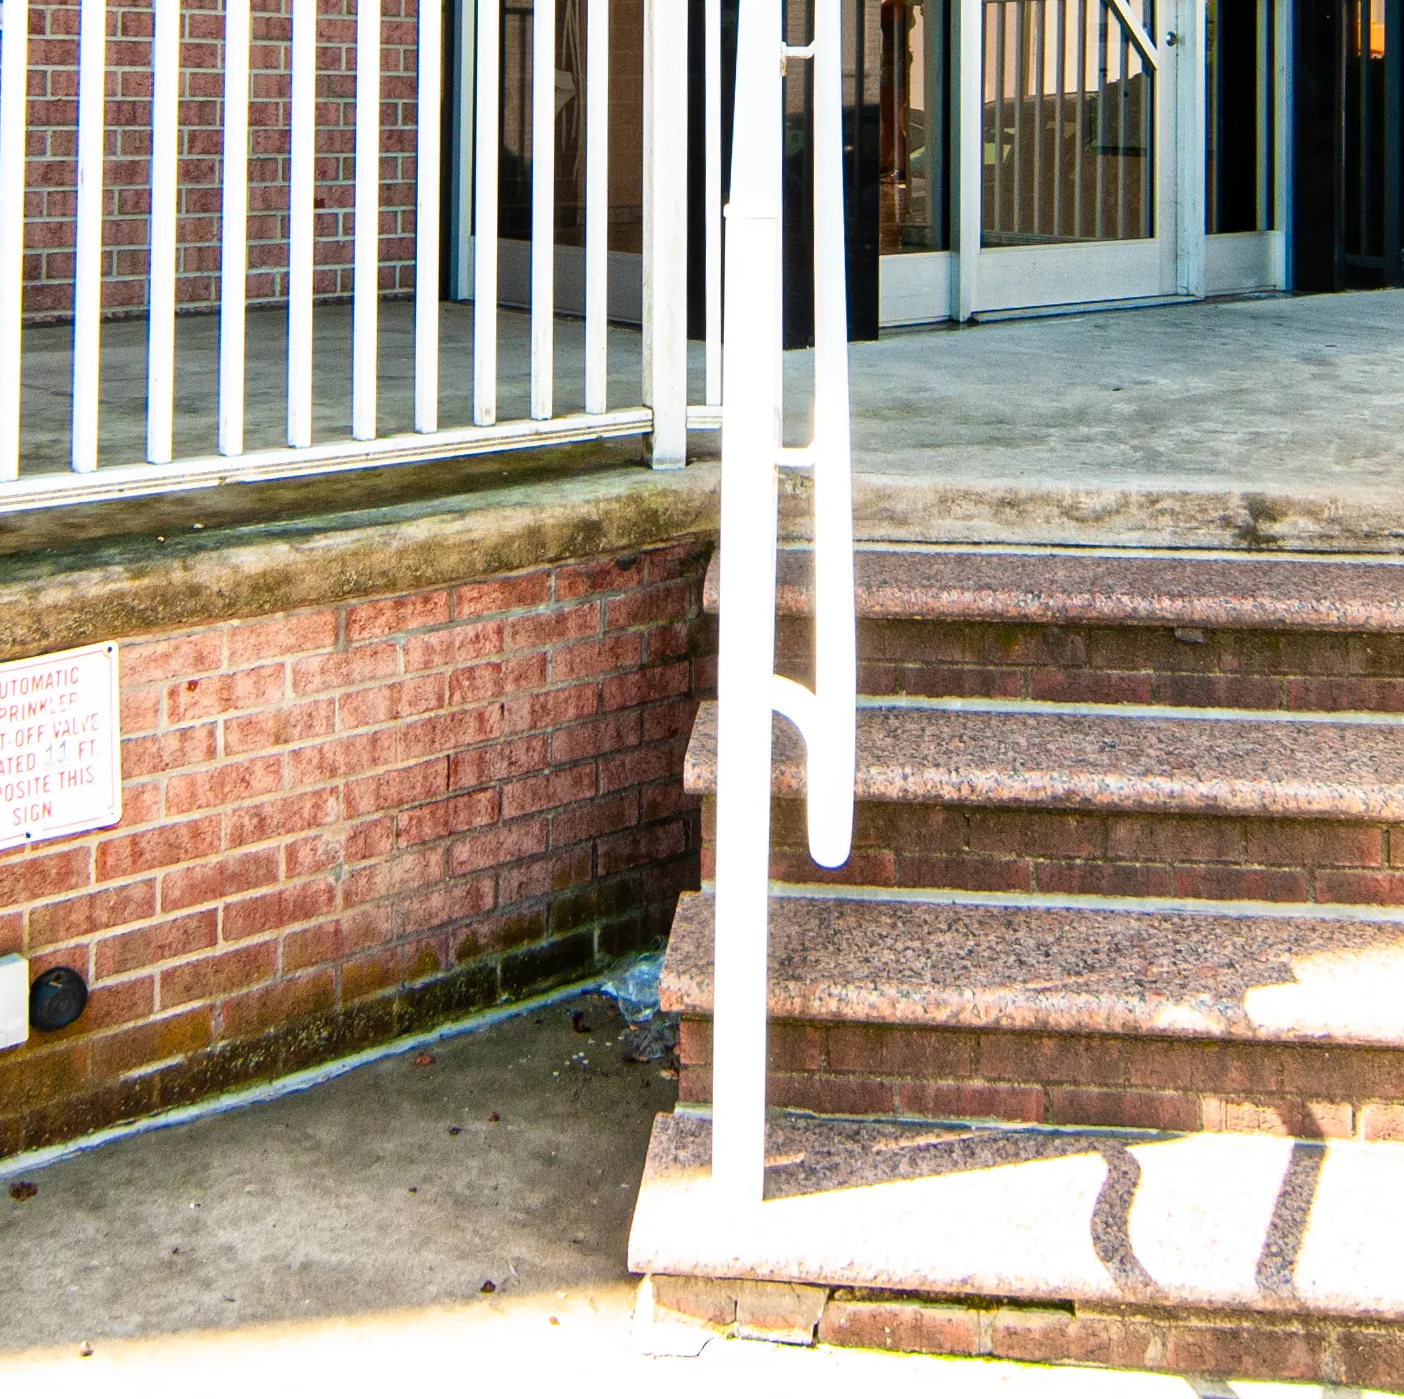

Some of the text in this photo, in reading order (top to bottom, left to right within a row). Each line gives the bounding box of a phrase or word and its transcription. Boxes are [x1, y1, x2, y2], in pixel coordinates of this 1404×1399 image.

[52, 712, 99, 740] VALVE
[58, 765, 95, 789] THIS
[12, 800, 52, 827] SIGN
